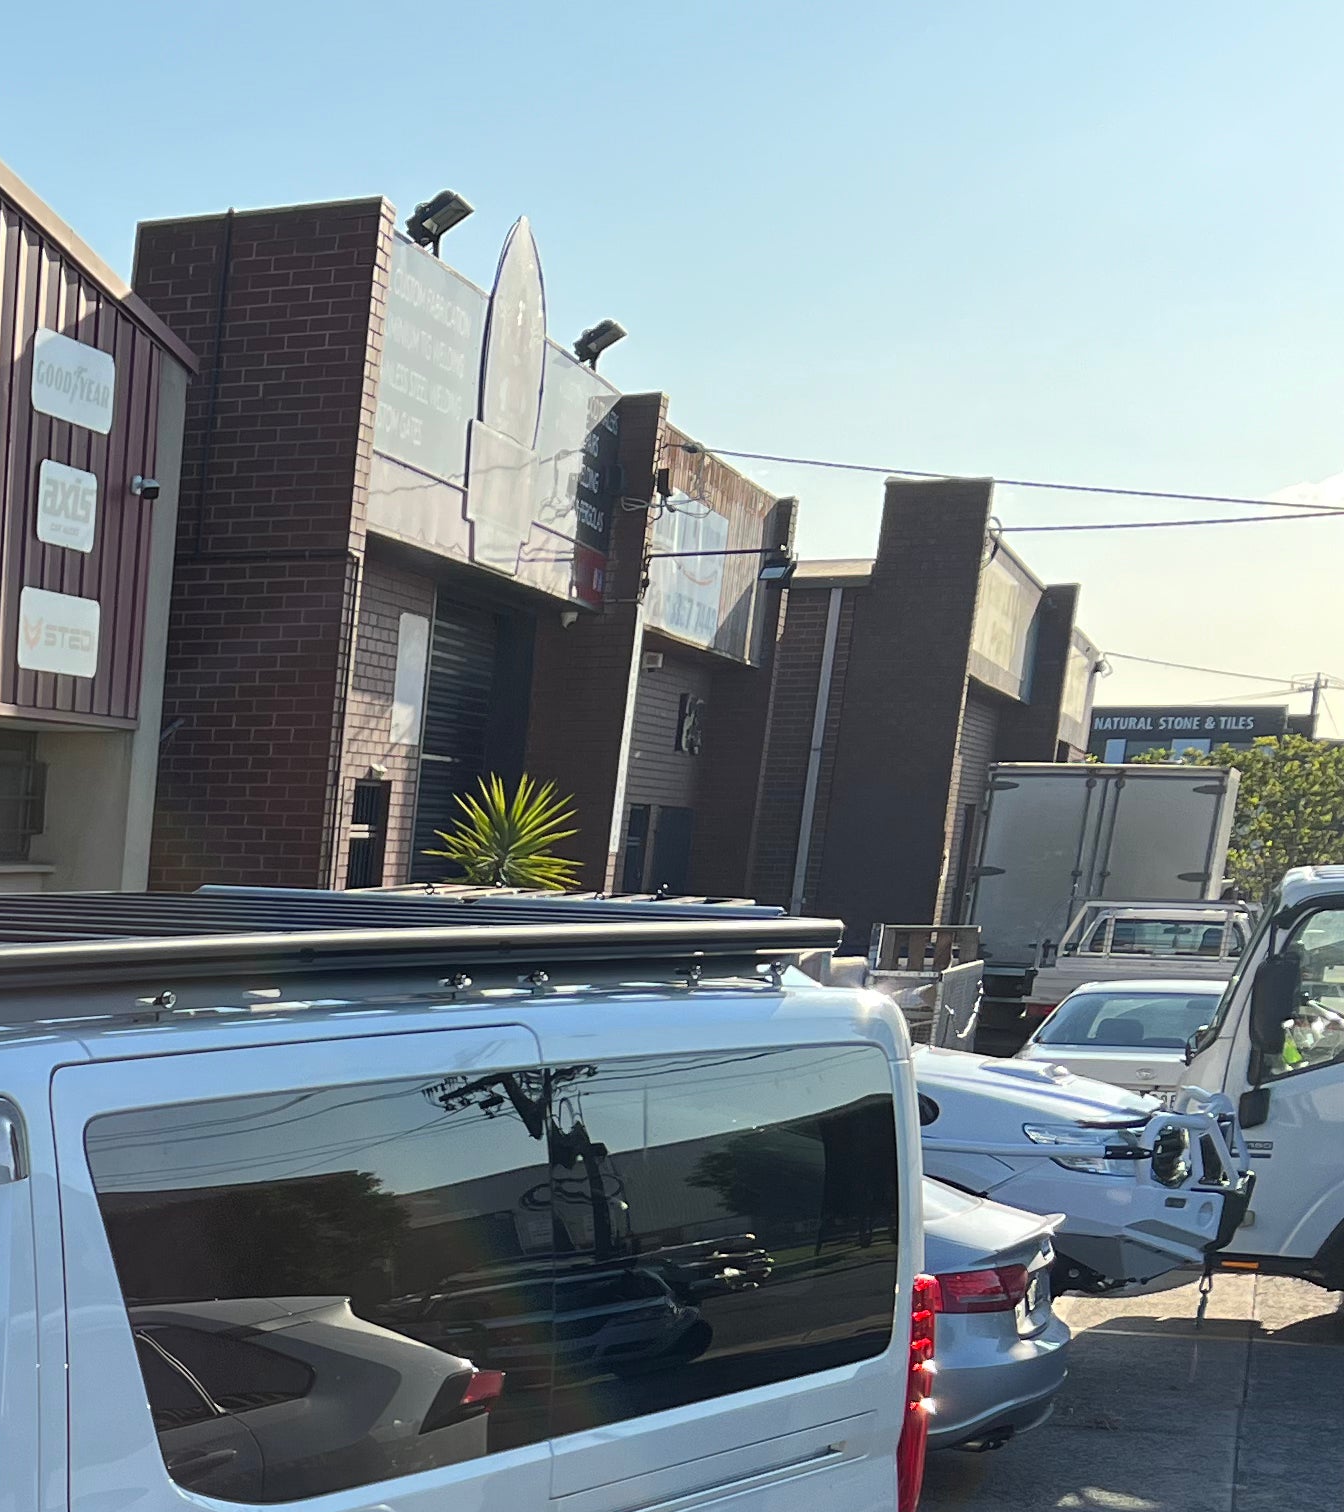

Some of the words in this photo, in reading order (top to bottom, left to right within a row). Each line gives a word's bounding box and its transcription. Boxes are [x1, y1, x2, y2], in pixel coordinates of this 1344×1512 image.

[37, 360, 110, 408] GOODYEAR
[41, 479, 96, 524] axis
[1094, 716, 1153, 730] NATURAL
[1159, 716, 1200, 730] STONE
[1204, 716, 1216, 730] &
[1220, 716, 1255, 730] TILES
